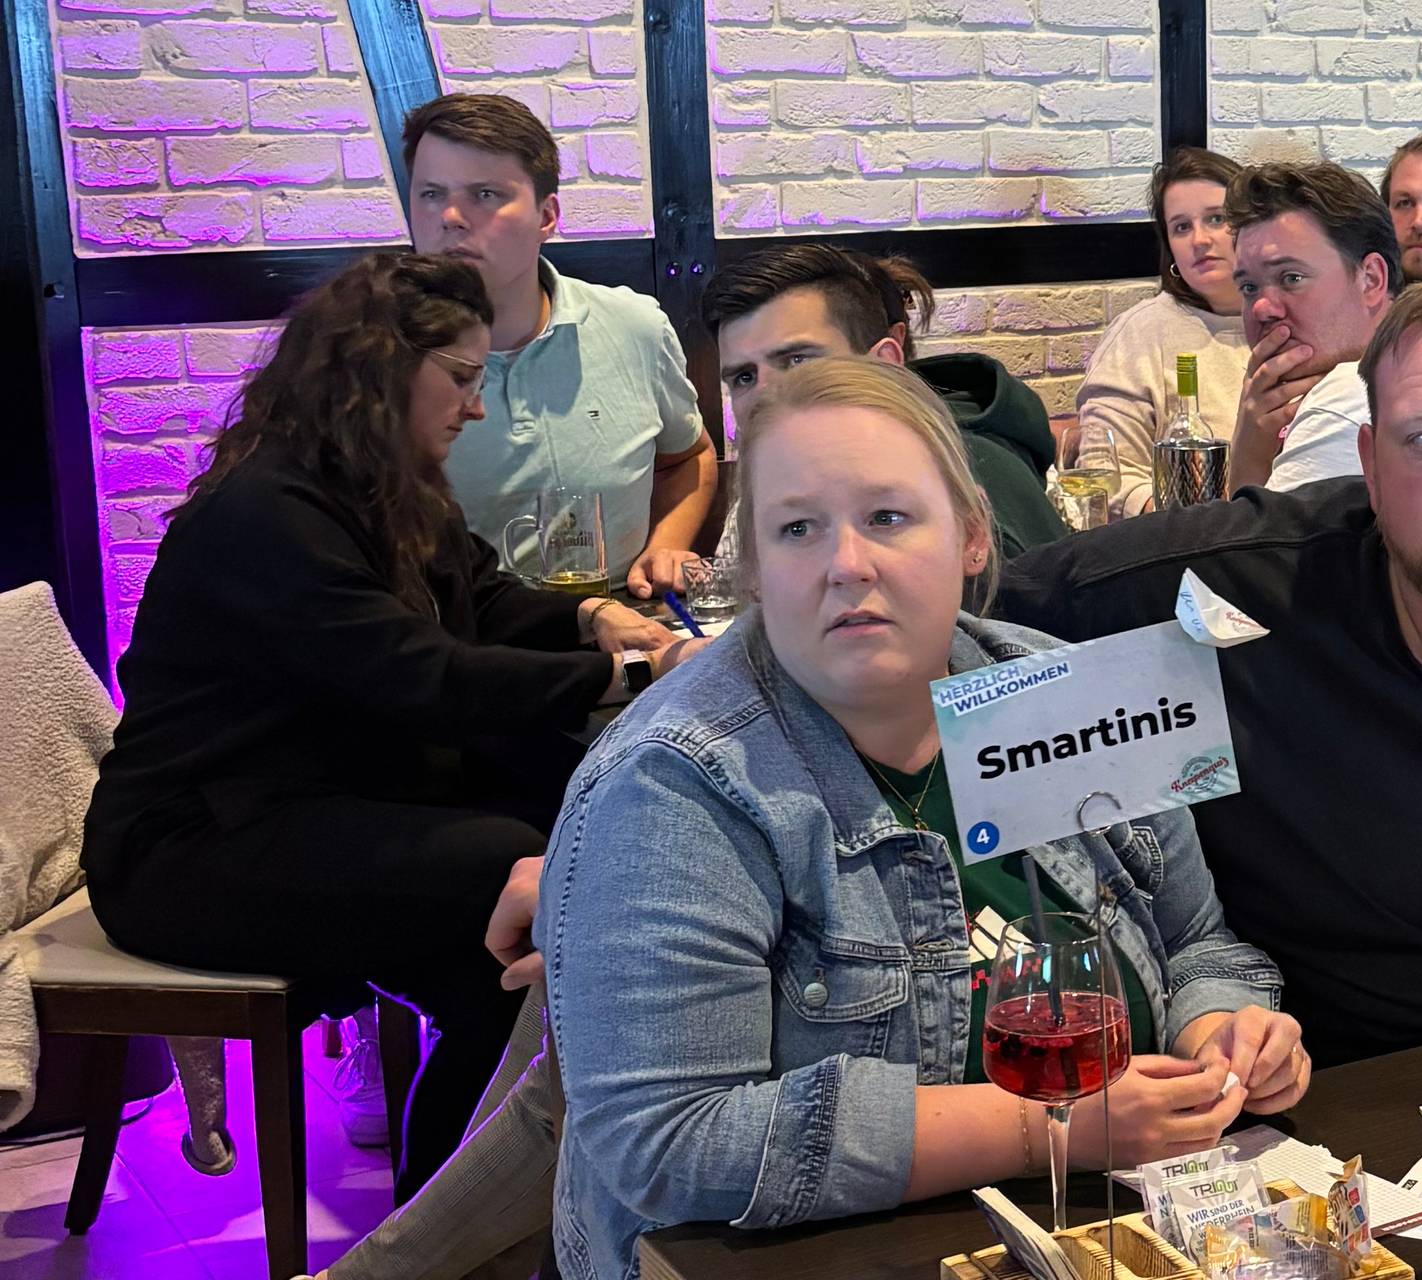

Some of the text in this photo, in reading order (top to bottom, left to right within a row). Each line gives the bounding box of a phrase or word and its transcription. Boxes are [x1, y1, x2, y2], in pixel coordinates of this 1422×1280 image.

[940, 666, 1020, 703] HERZLICH
[954, 663, 1069, 712] WILLKOMMEN
[977, 697, 1196, 779] Smartinis
[976, 828, 990, 844] 4
[1187, 1199, 1244, 1223] WIR SIND DER
